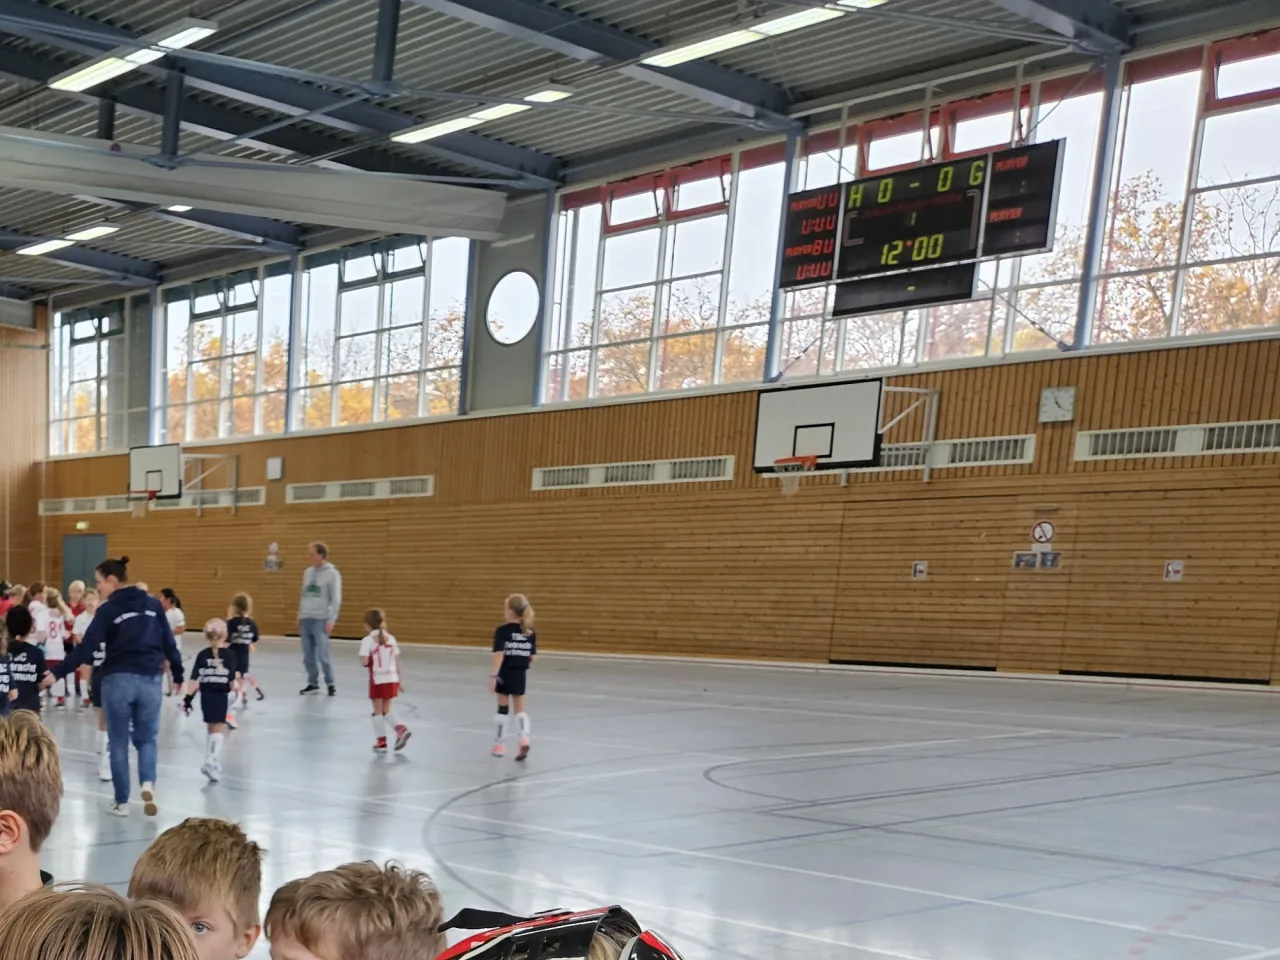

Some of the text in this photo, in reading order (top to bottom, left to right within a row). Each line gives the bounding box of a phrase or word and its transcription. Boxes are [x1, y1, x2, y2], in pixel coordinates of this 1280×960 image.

[847, 184, 864, 209] H
[877, 177, 893, 203] 0
[936, 167, 953, 192] 0
[969, 160, 985, 186] G
[989, 207, 1023, 222] PLAYER
